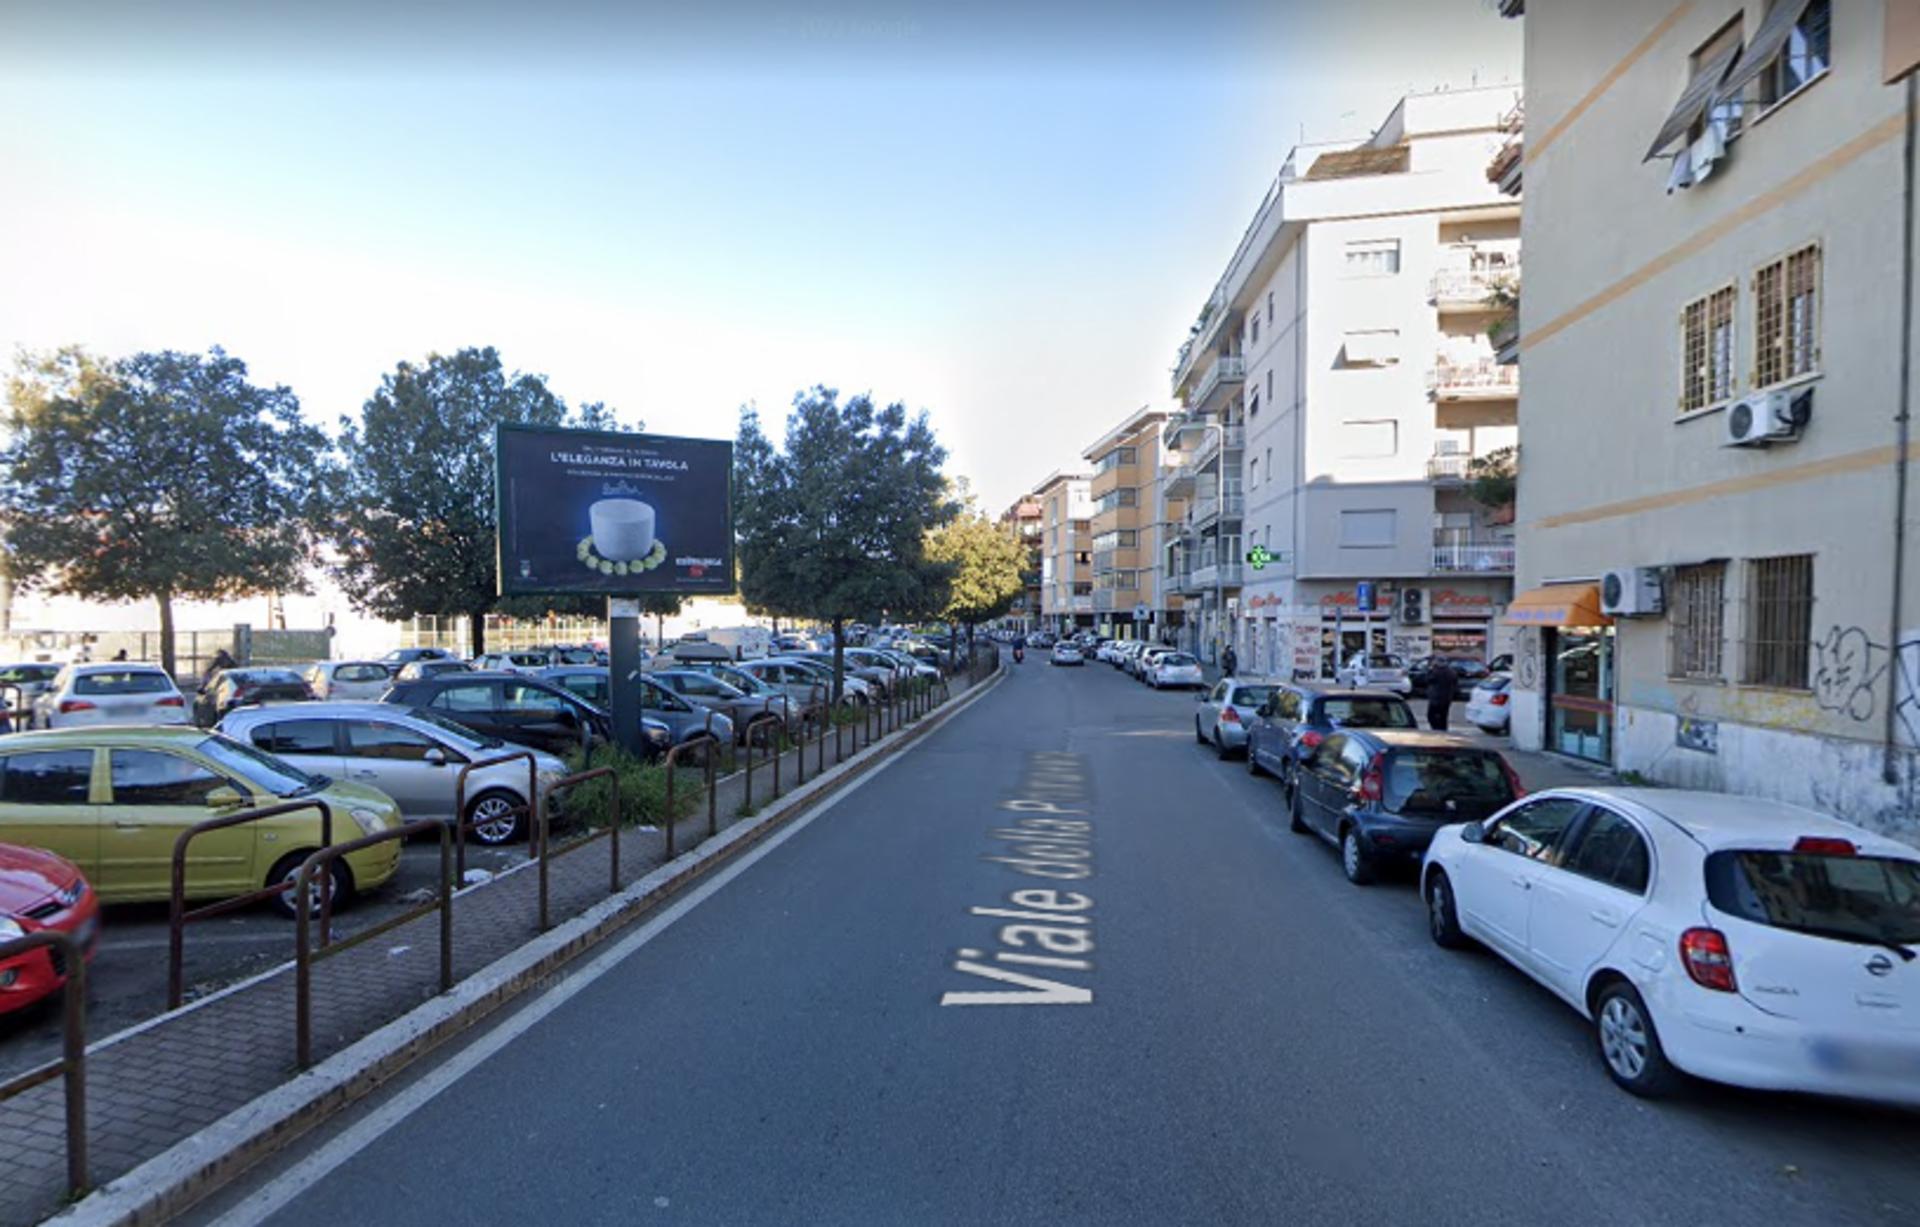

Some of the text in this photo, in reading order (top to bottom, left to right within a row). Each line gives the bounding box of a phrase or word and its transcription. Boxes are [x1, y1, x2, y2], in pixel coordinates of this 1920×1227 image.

[550, 452, 689, 471] L'ELEGANZA IN TAVOLA
